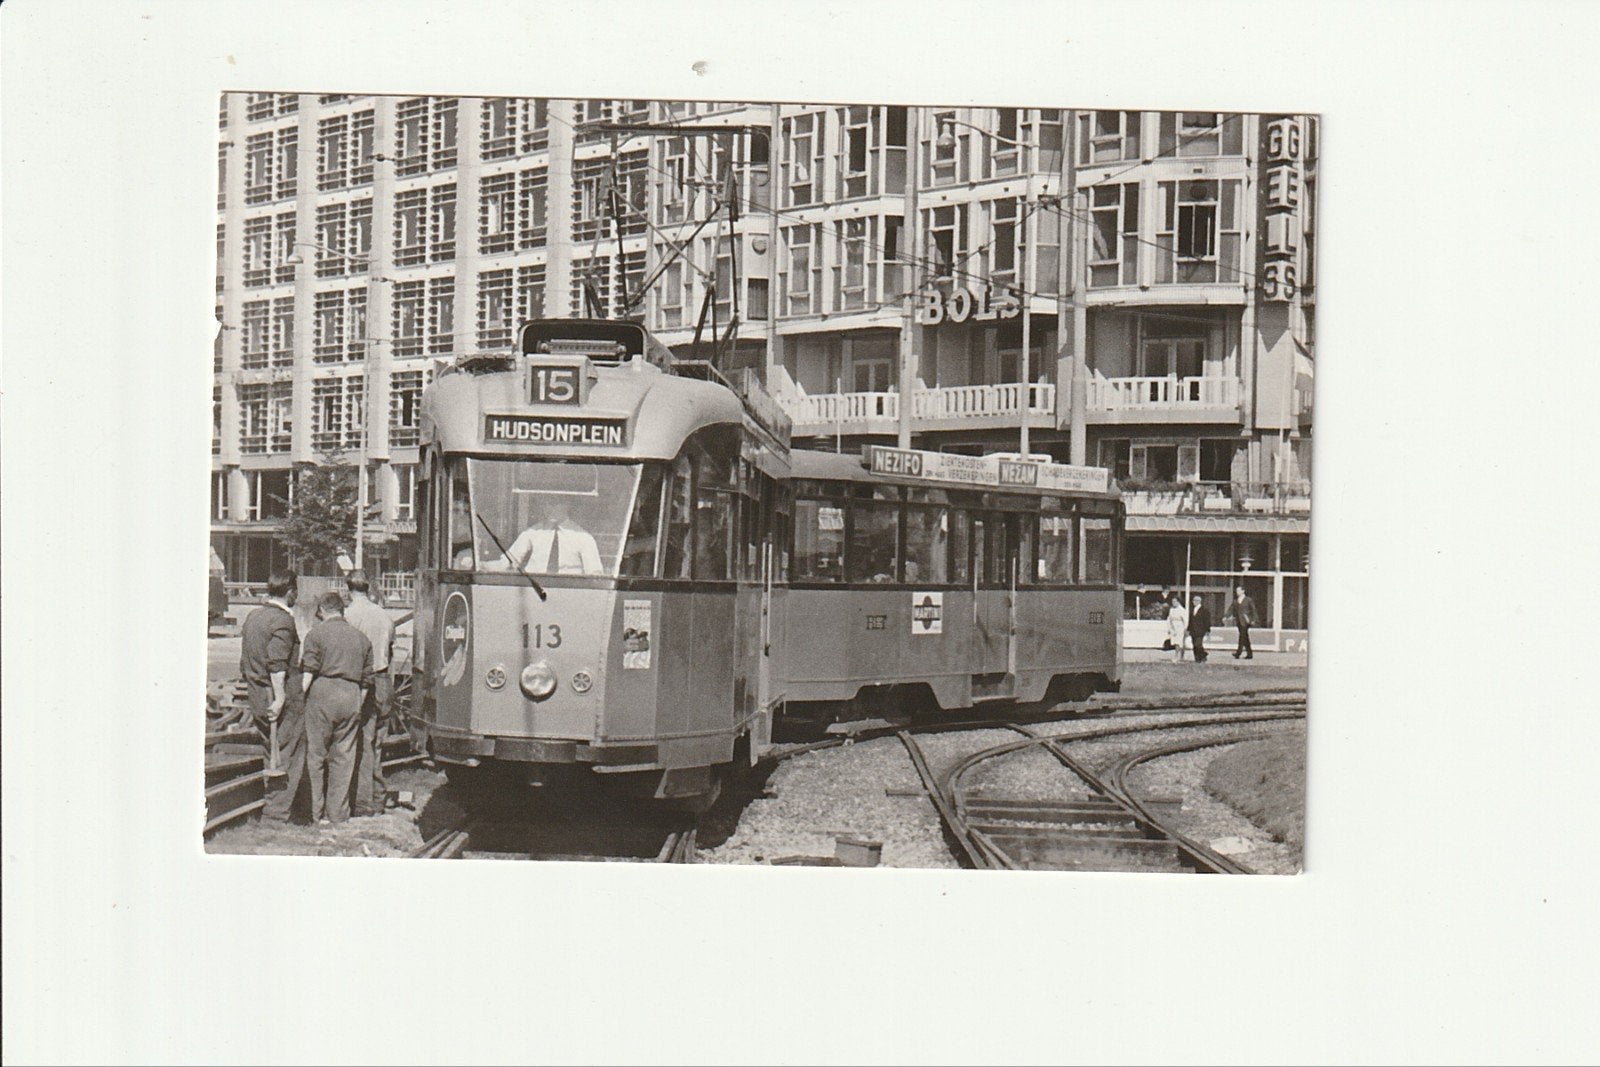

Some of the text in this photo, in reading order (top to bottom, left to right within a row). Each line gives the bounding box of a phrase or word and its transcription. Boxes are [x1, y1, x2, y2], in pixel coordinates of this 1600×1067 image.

[921, 284, 1020, 325] BOLS
[537, 369, 575, 401] 15
[493, 420, 622, 445] HUDSONPLEIN
[875, 450, 920, 475] NEZIFO
[521, 623, 562, 649] 113
